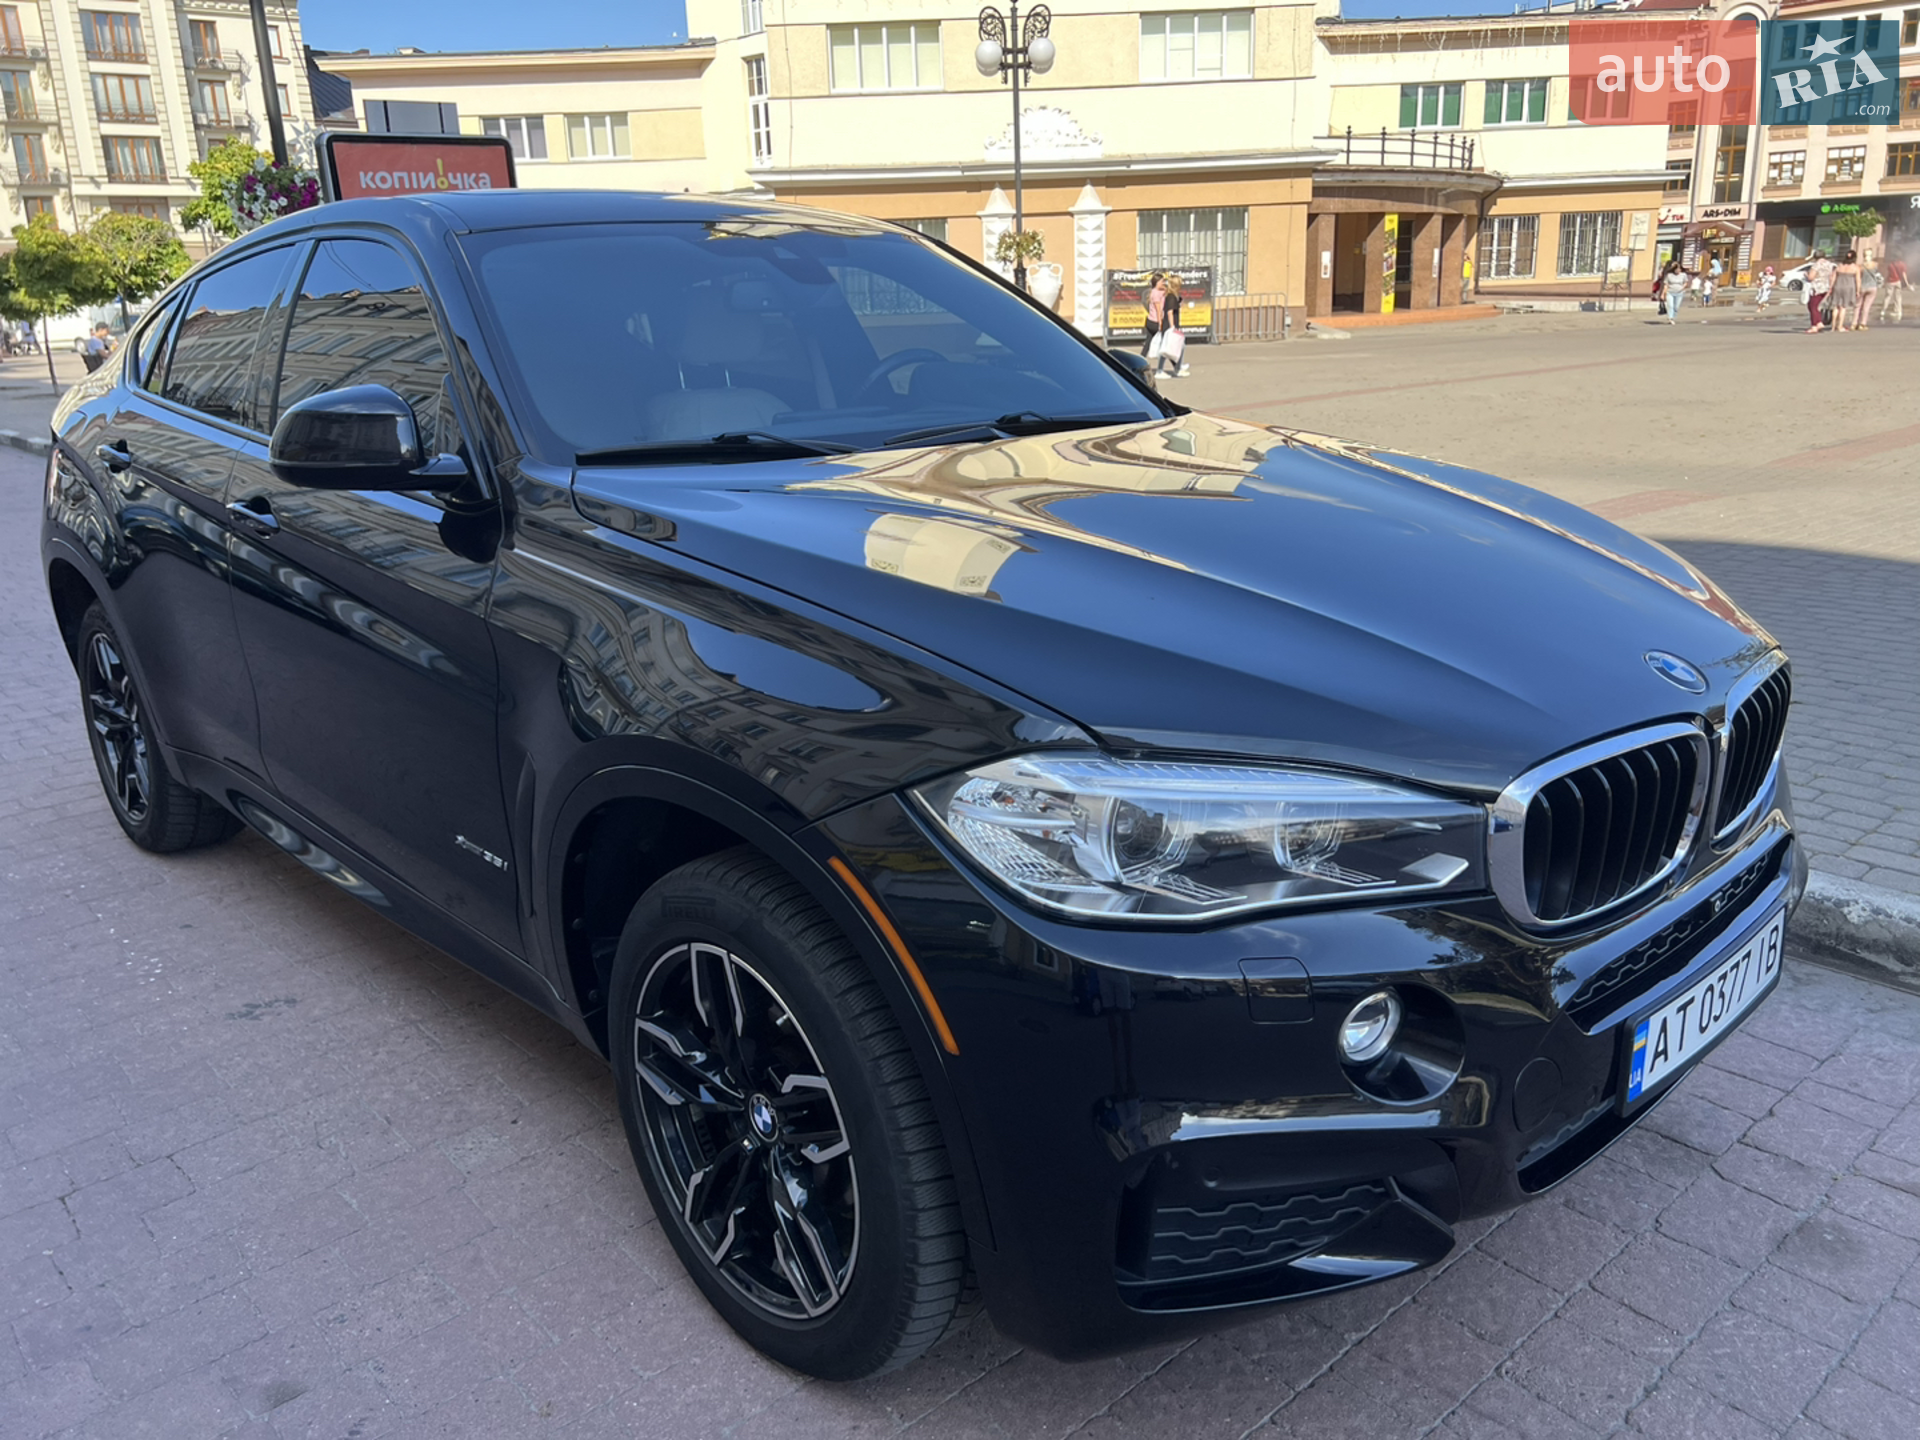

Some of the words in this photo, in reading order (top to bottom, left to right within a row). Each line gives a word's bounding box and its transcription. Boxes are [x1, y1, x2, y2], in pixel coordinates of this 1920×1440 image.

[1649, 995, 1695, 1074] AT
[1698, 948, 1752, 1035] 0377
[1757, 923, 1780, 984] IB
